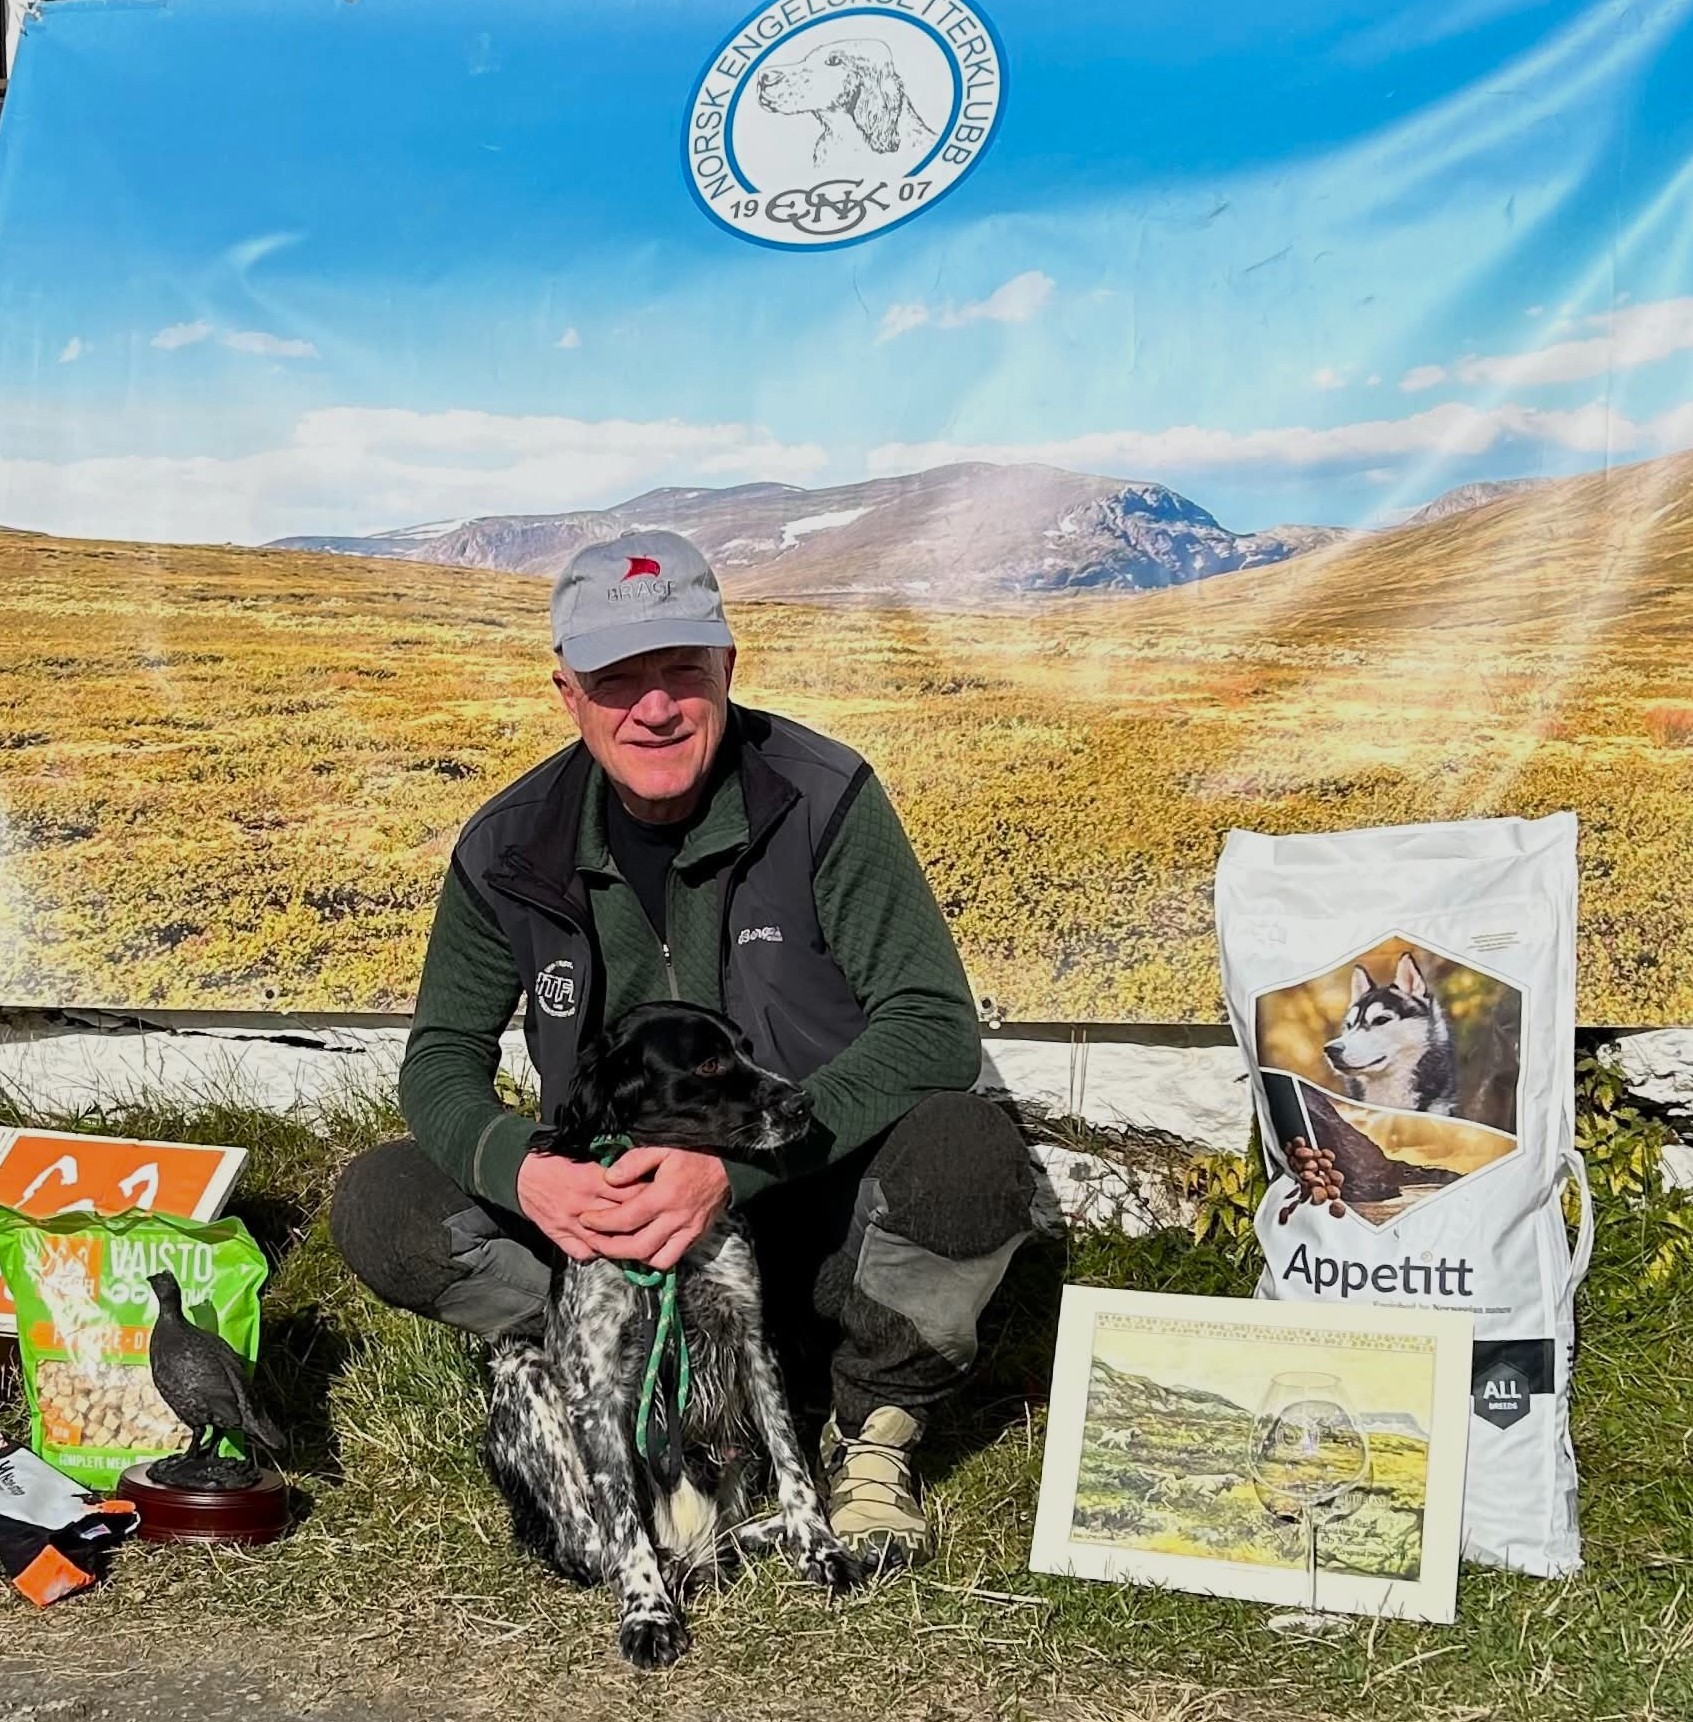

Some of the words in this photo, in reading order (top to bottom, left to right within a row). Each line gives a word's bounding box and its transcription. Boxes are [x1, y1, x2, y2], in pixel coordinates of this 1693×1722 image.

[694, 87, 735, 200] NORSK
[899, 181, 932, 201] 07
[729, 200, 759, 219] 19
[109, 1238, 213, 1283] VAISTO
[1282, 1243, 1474, 1298] Appetitt
[1483, 1380, 1522, 1399] ALL
